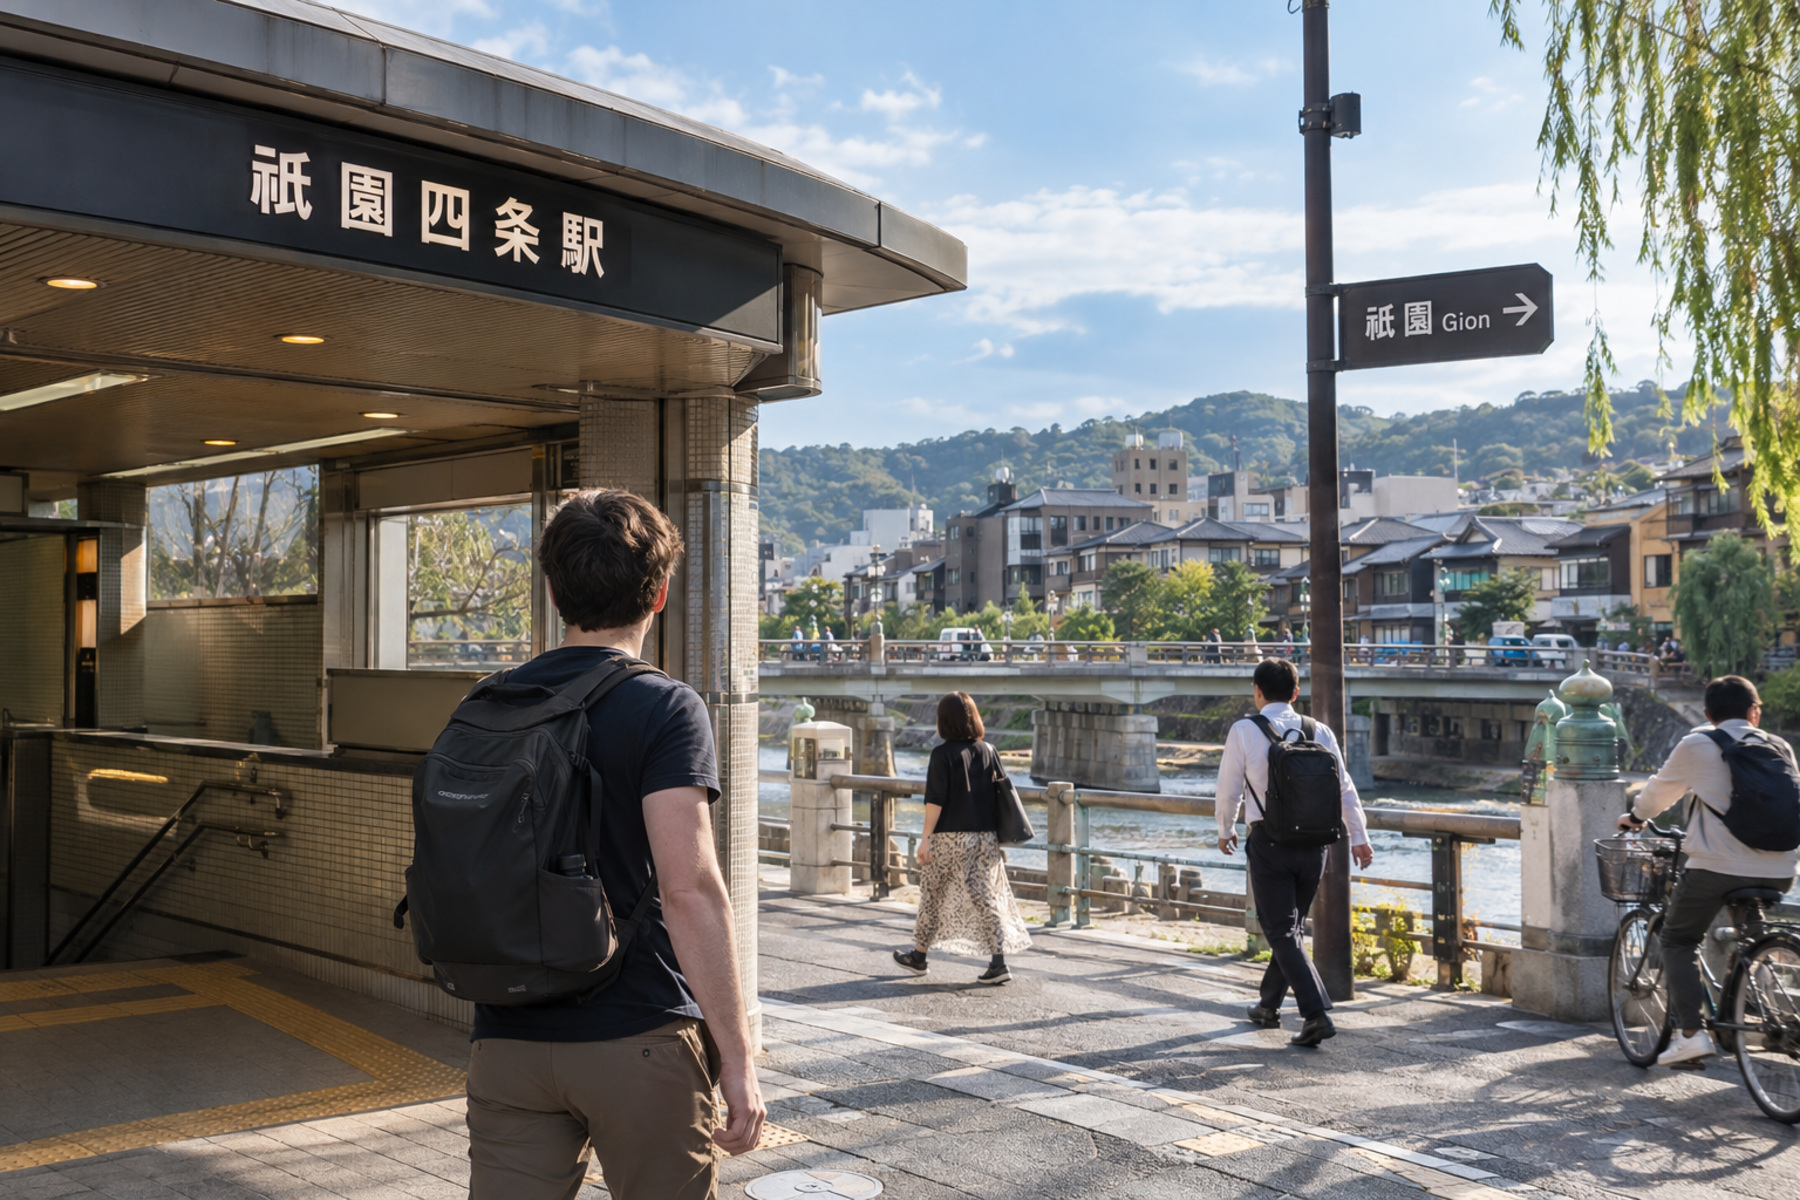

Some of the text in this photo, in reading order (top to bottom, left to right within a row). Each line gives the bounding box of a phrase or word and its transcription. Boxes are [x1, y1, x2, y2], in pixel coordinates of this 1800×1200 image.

[250, 144, 605, 278] 祇園四条駅
[1365, 300, 1490, 341] 祇園 Gion
